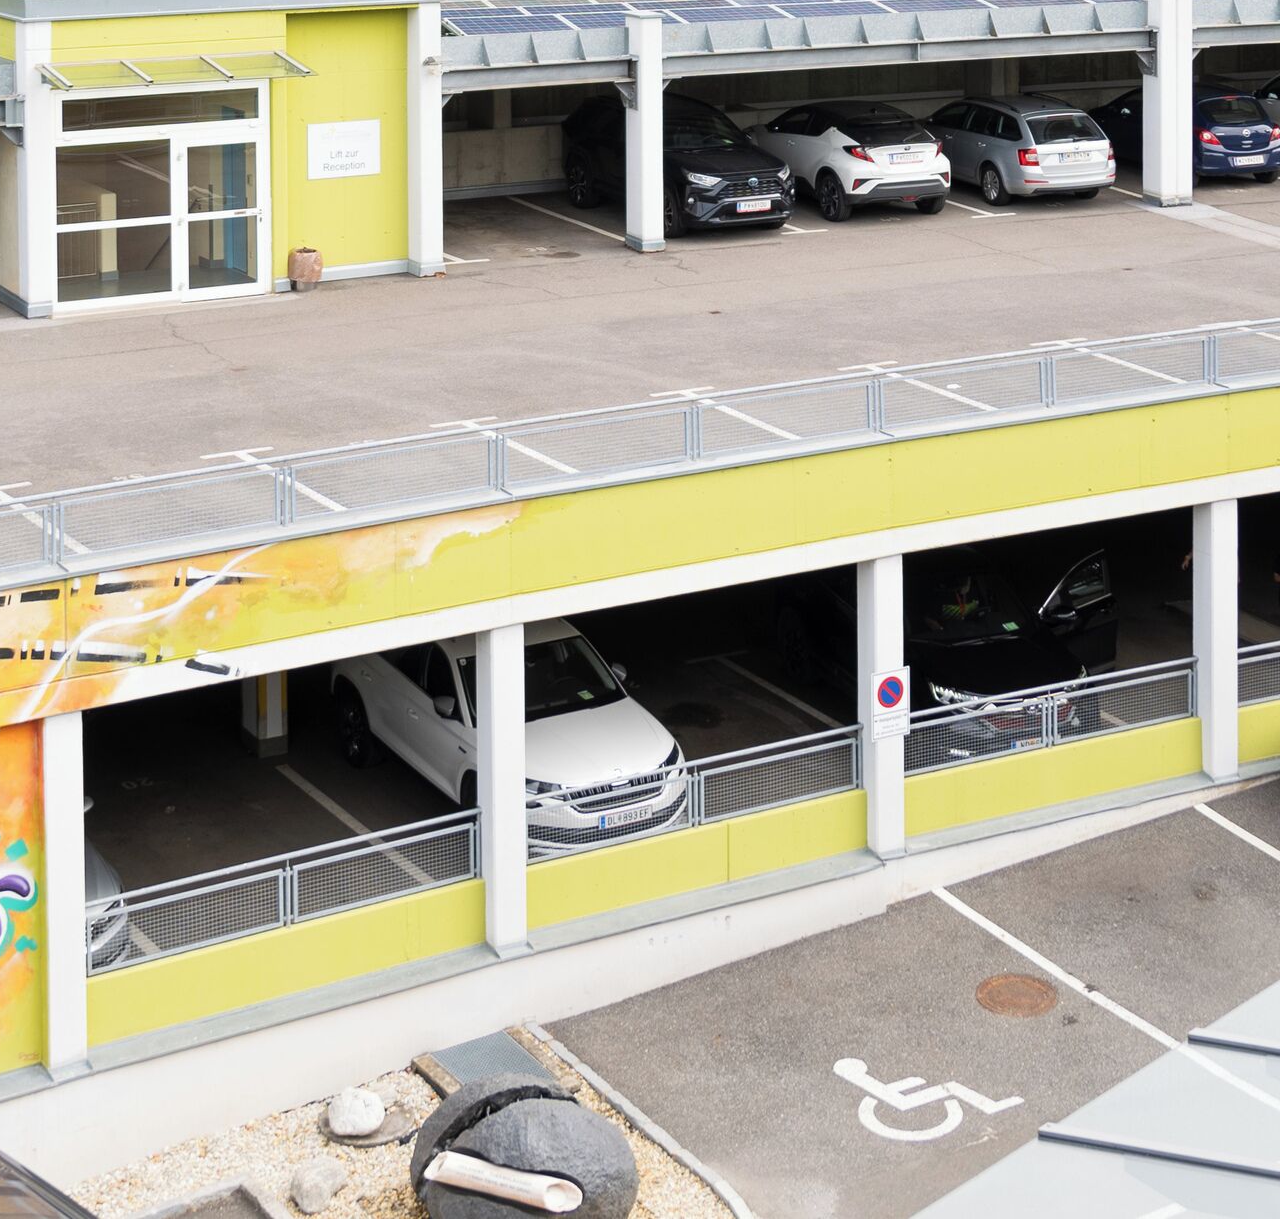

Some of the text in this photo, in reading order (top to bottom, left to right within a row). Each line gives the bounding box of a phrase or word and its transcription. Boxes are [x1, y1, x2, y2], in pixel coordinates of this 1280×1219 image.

[329, 148, 359, 160] Lift zur
[322, 159, 366, 173] Reception
[622, 811, 638, 822] 893
[639, 808, 650, 819] EF
